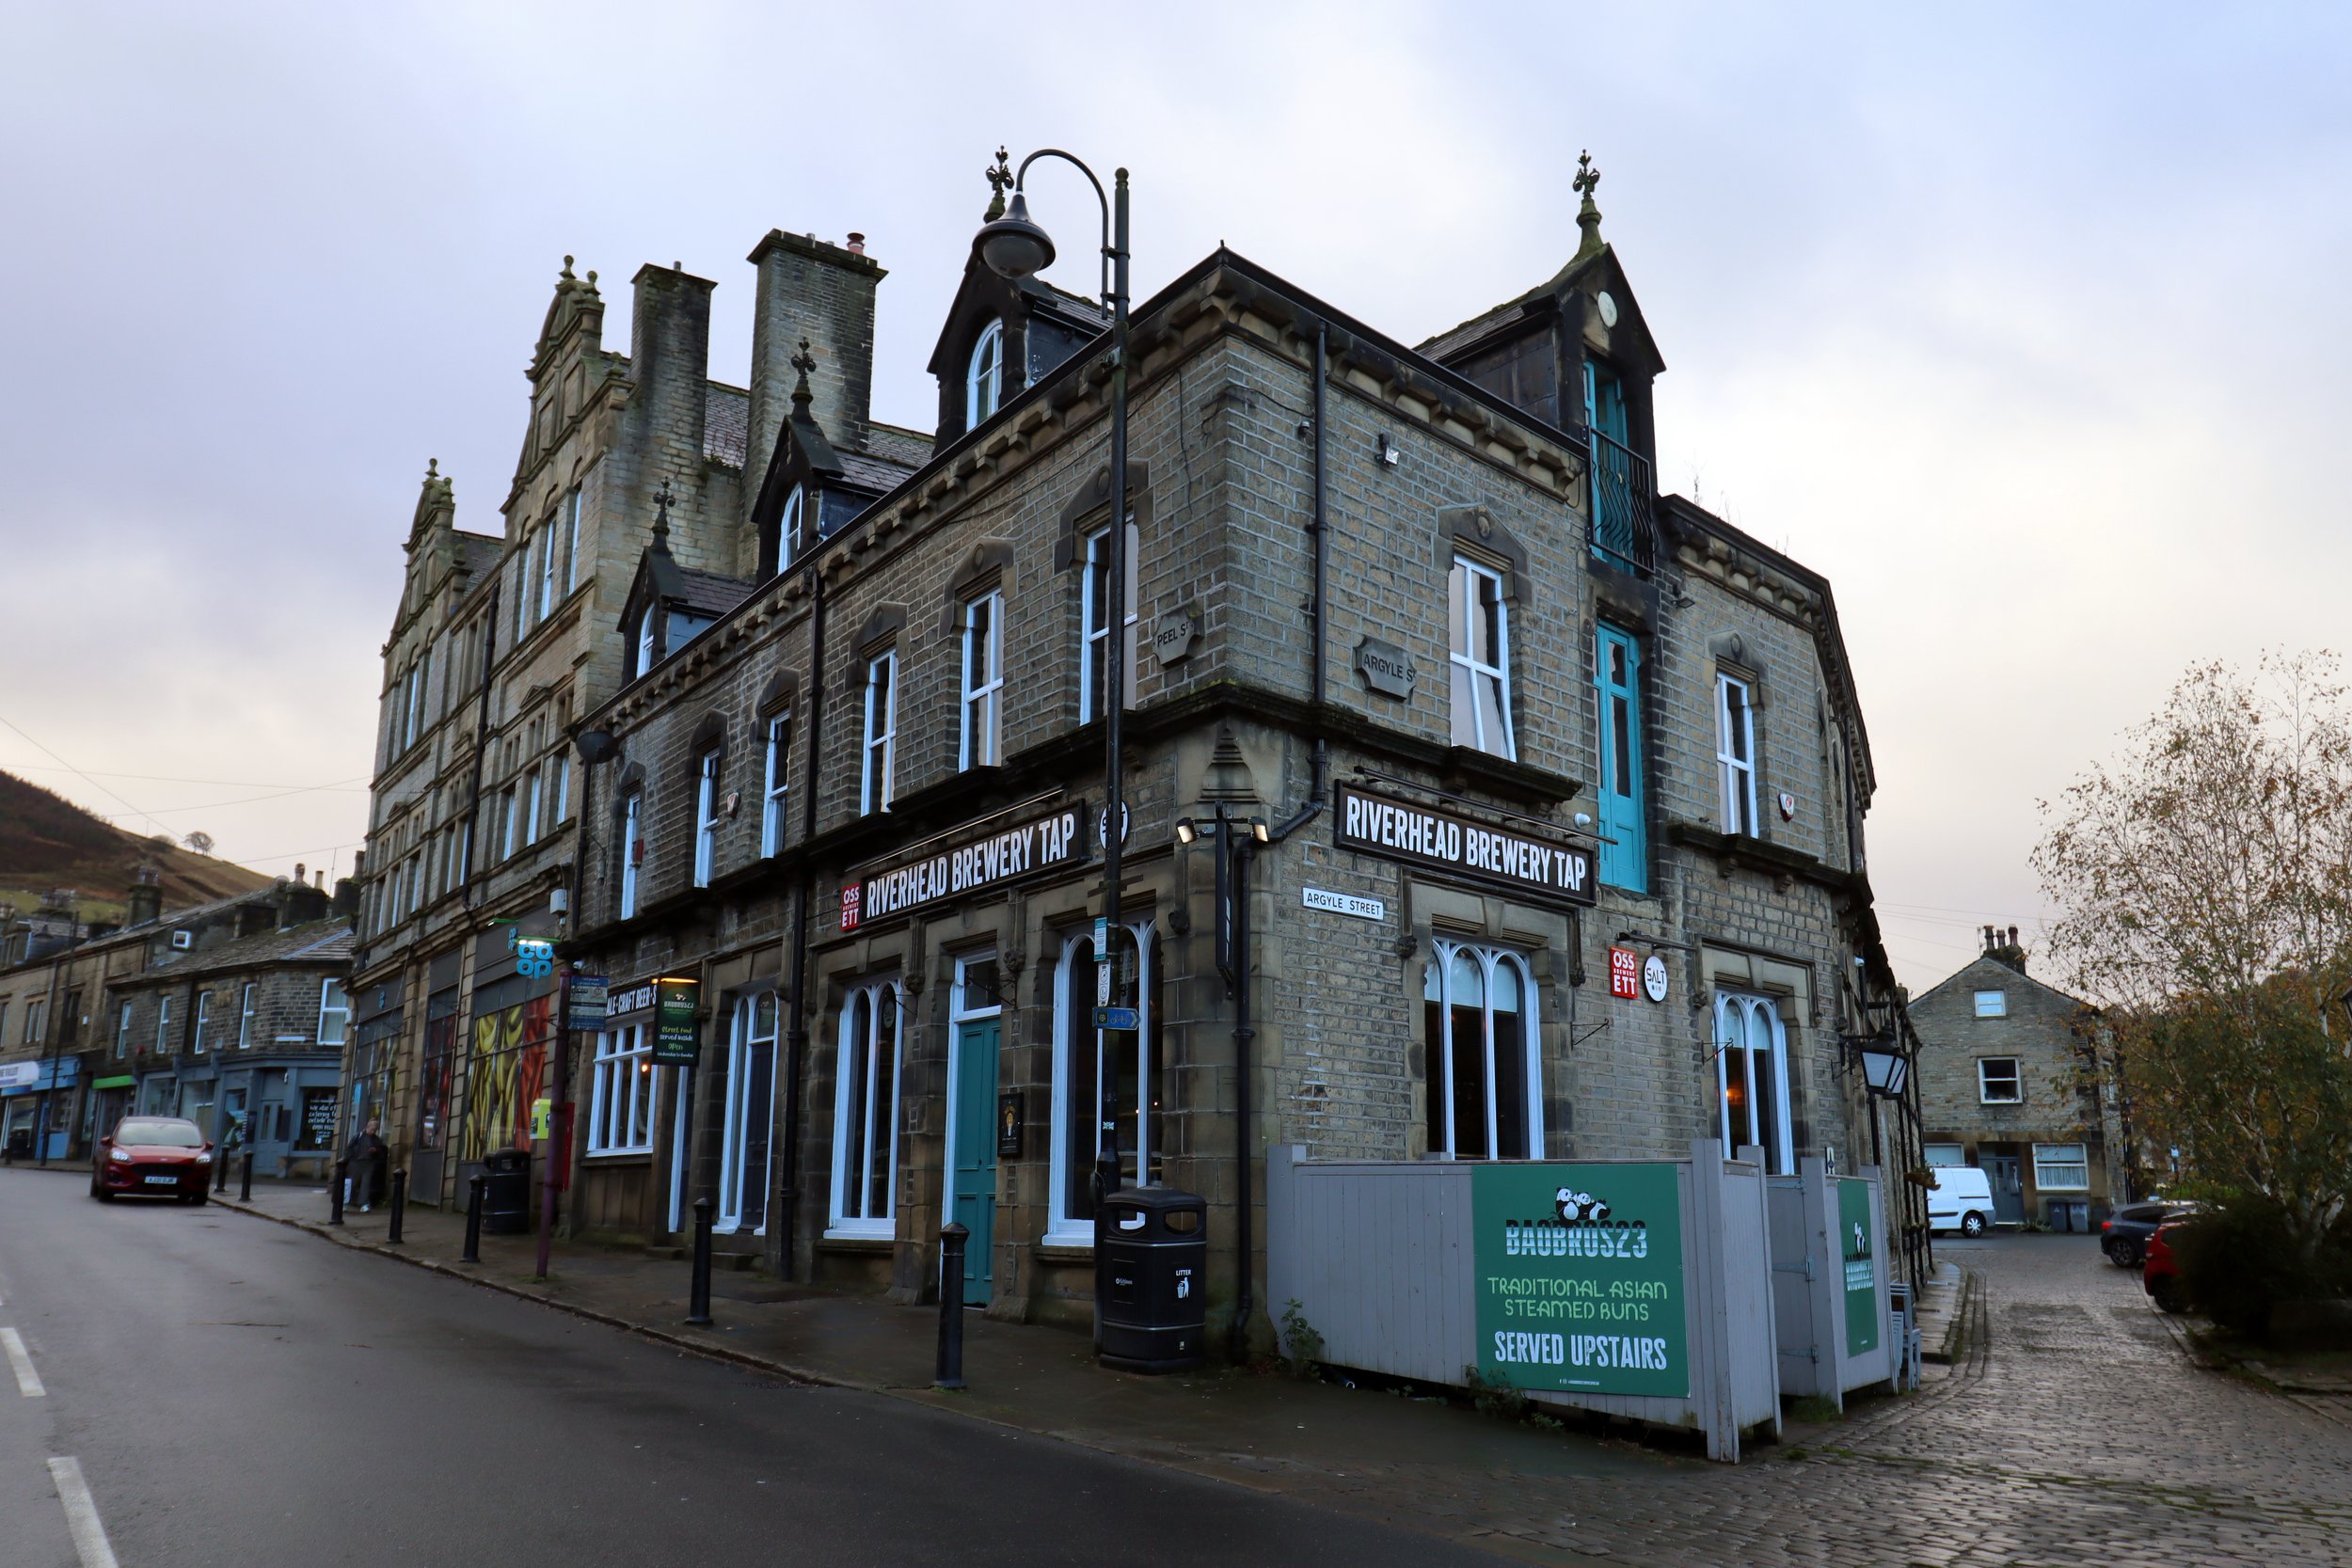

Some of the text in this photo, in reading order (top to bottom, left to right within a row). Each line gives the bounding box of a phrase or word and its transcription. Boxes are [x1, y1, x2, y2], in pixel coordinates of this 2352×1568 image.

[1157, 627, 1178, 647] PEEL
[1363, 654, 1403, 679] ARGYLE
[1346, 795, 1586, 892] RIVERHEAD BREWERY TAP
[866, 813, 1075, 918] RIVERHEAD BREWERY TAP
[843, 887, 860, 904] OSS
[1307, 892, 1380, 916] ARGYLE STREET
[842, 909, 859, 927] ETT
[1613, 951, 1635, 970] OSS
[1613, 968, 1635, 976] BREWERY
[1613, 974, 1636, 995] ETT
[1646, 967, 1665, 985] SALT
[618, 990, 636, 1013] CRAFT
[636, 986, 651, 1009] BEER
[1505, 1220, 1647, 1259] BAOBROS23
[1487, 1277, 1668, 1300] TRADITIONAL ASIAN
[1505, 1299, 1649, 1322] STEAMED BUNS
[1494, 1331, 1667, 1370] SERVED UPSTAIRS
